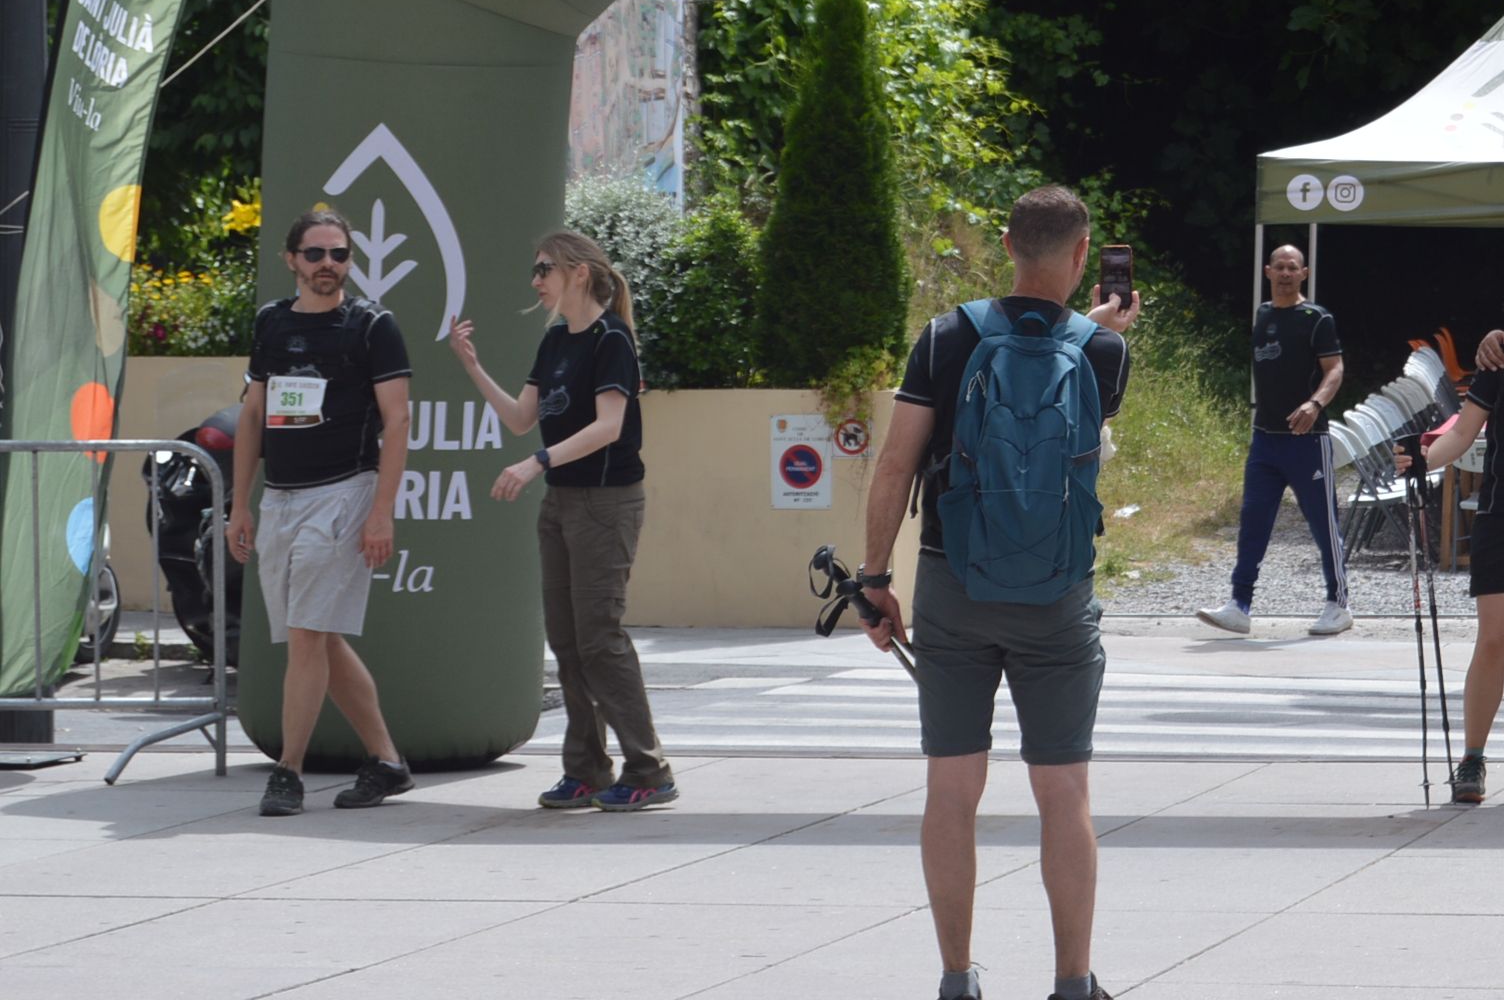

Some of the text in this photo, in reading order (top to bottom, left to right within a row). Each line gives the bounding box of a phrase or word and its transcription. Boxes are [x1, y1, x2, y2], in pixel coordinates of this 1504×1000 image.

[102, 1, 154, 53] JULIÀ
[72, 20, 129, 89] DE LÒRIA
[67, 77, 102, 132] Viu-la
[280, 391, 304, 407] 351
[394, 470, 473, 520] RIA
